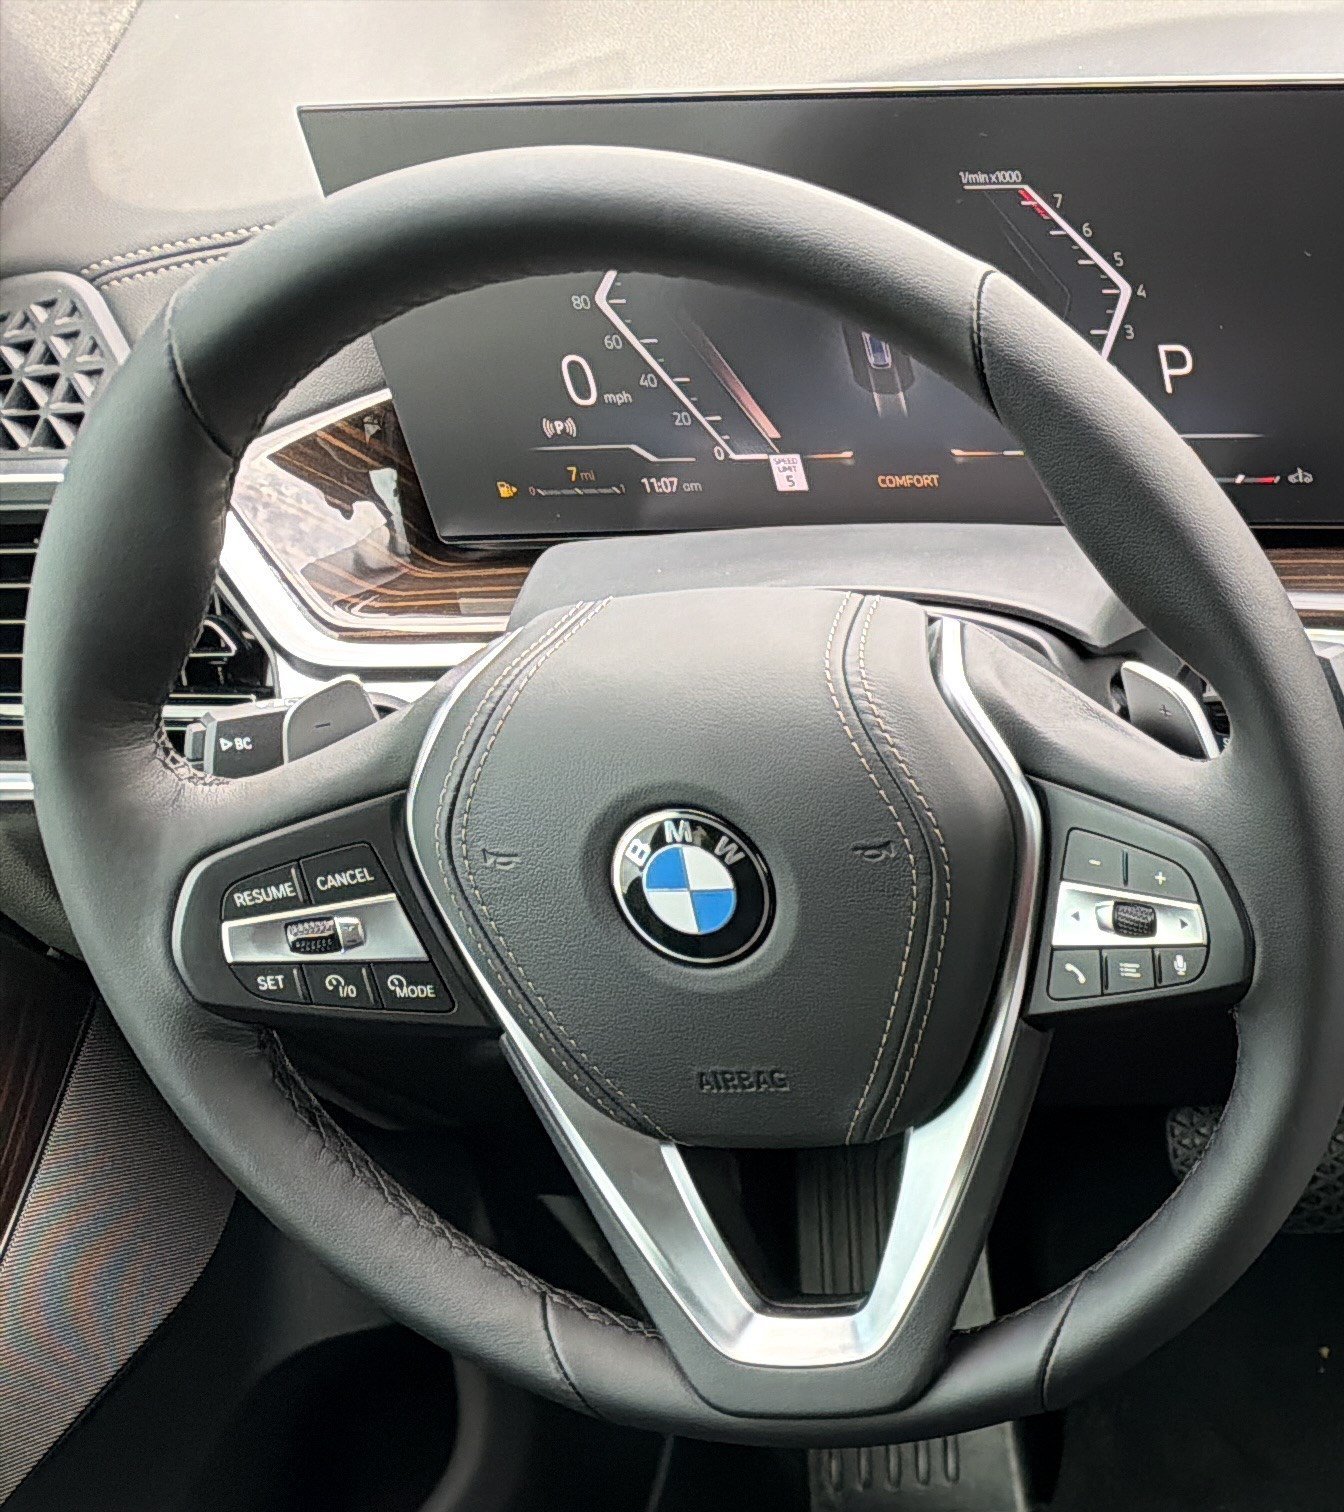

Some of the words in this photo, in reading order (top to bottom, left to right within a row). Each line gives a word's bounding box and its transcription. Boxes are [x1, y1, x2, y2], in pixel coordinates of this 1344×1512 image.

[1053, 194, 1063, 209] 7
[1083, 223, 1093, 238] 6
[1114, 252, 1124, 267] 5
[1137, 284, 1147, 299] 4
[571, 295, 591, 310] 80
[1124, 325, 1135, 340] 3
[604, 334, 623, 350] 60
[1158, 344, 1193, 394] P
[561, 354, 597, 406] 0
[604, 391, 632, 406] mph
[639, 373, 657, 388] 40
[673, 411, 691, 427] 20
[714, 446, 725, 461] 0
[566, 466, 578, 482] 7
[786, 475, 796, 487] 5
[878, 474, 939, 488] COMFORT
[640, 477, 678, 494] 11:07
[234, 736, 253, 751] BC
[625, 819, 746, 868] BMW
[316, 867, 374, 891] CANCEL
[233, 882, 296, 908] RESUME
[257, 975, 285, 991] SET
[396, 985, 436, 998] MODE
[700, 1069, 790, 1092] AIRBAG
